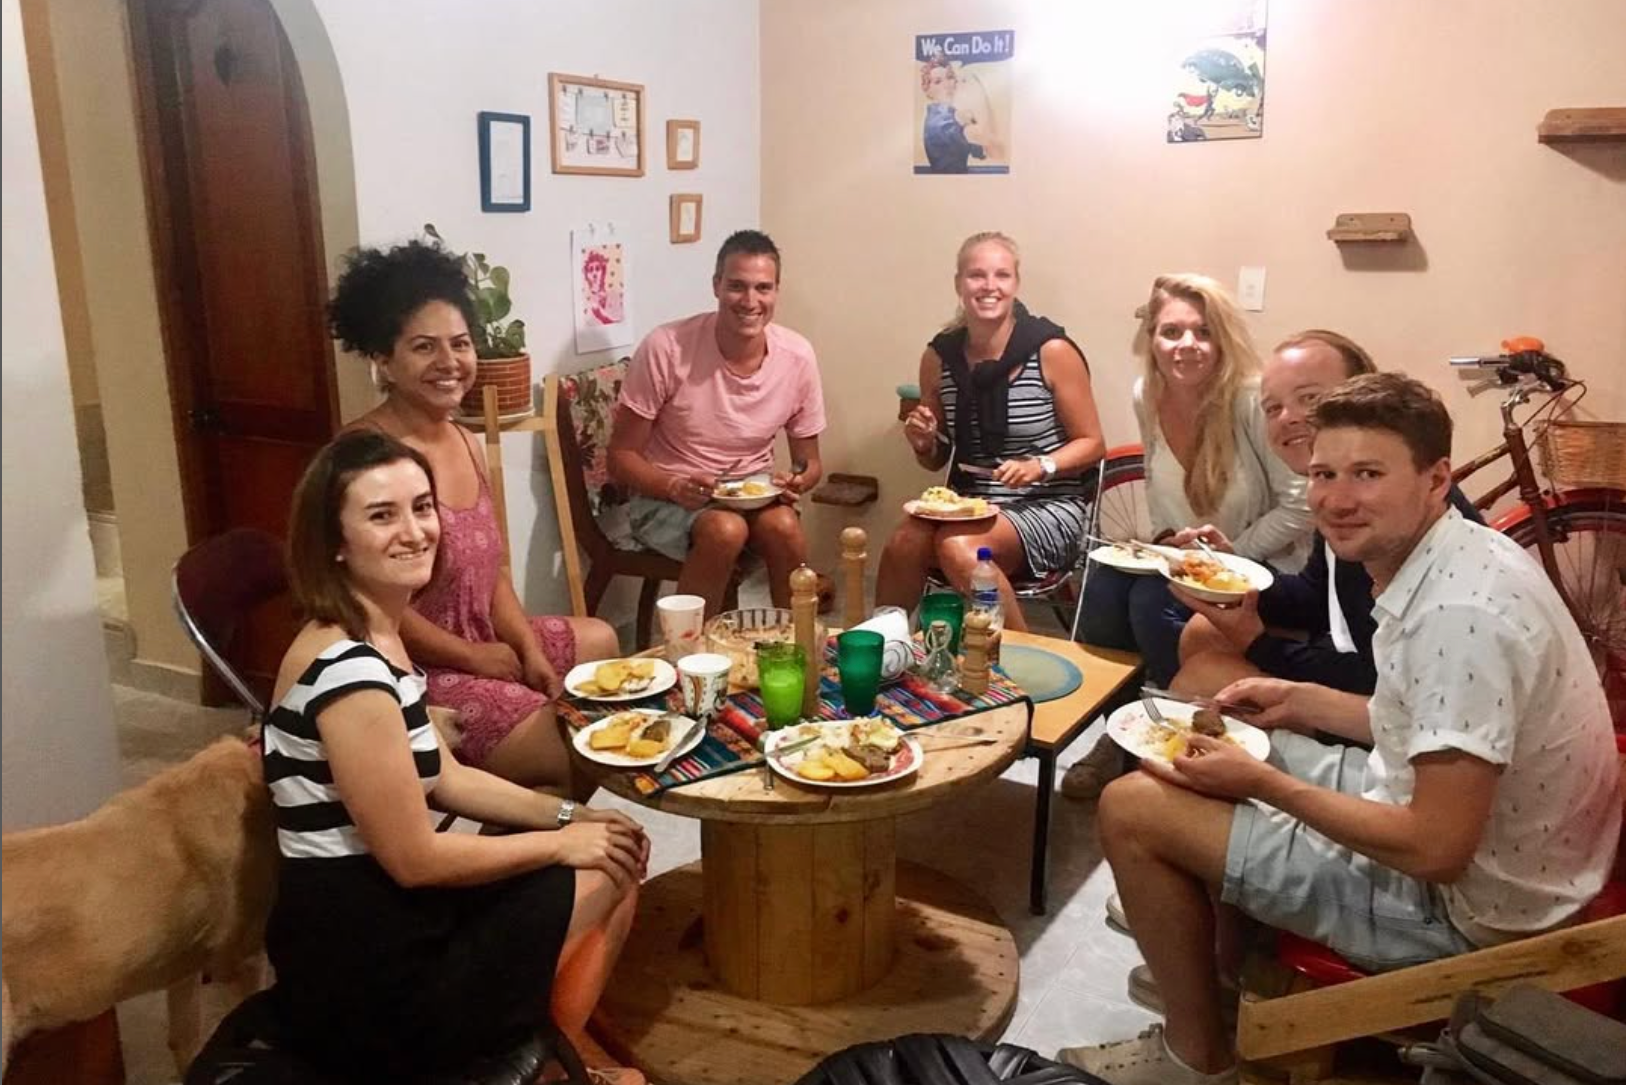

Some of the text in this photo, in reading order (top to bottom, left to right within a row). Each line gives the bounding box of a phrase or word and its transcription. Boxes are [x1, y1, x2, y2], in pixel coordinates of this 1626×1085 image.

[921, 35, 1010, 57] We Can Do It!
